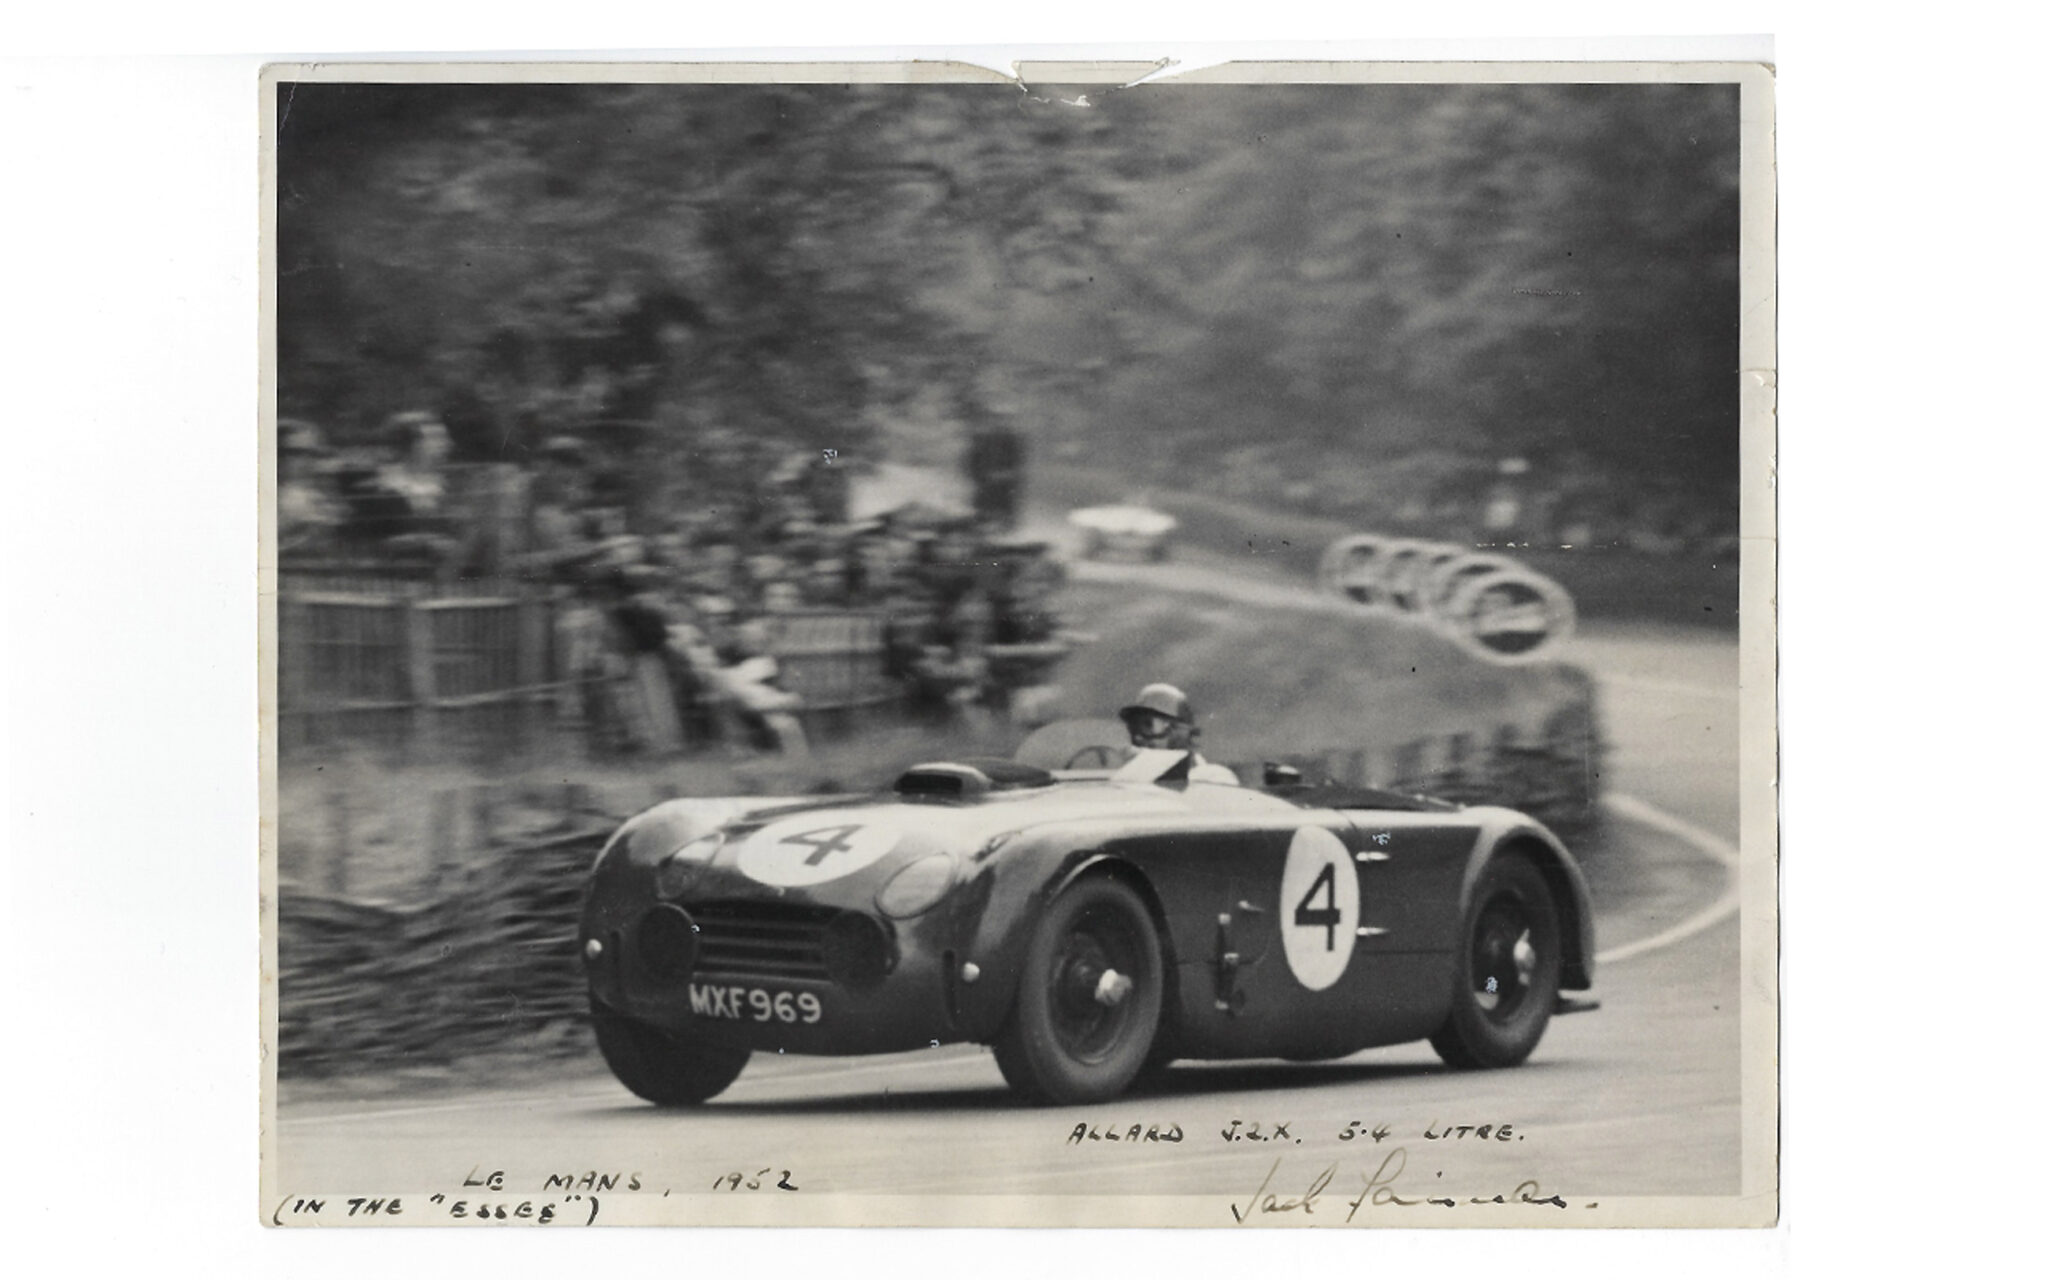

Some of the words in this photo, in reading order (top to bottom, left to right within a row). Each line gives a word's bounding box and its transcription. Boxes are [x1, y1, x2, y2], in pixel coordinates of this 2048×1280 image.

[778, 823, 867, 866] 4
[1294, 862, 1341, 952] 4
[1066, 1122, 1184, 1145] ALLARD
[1423, 1119, 1525, 1142] LITRE.
[463, 1164, 505, 1191] LE
[712, 1168, 799, 1192] 1952
[273, 1194, 327, 1226] (IN
[347, 1198, 403, 1217] THE
